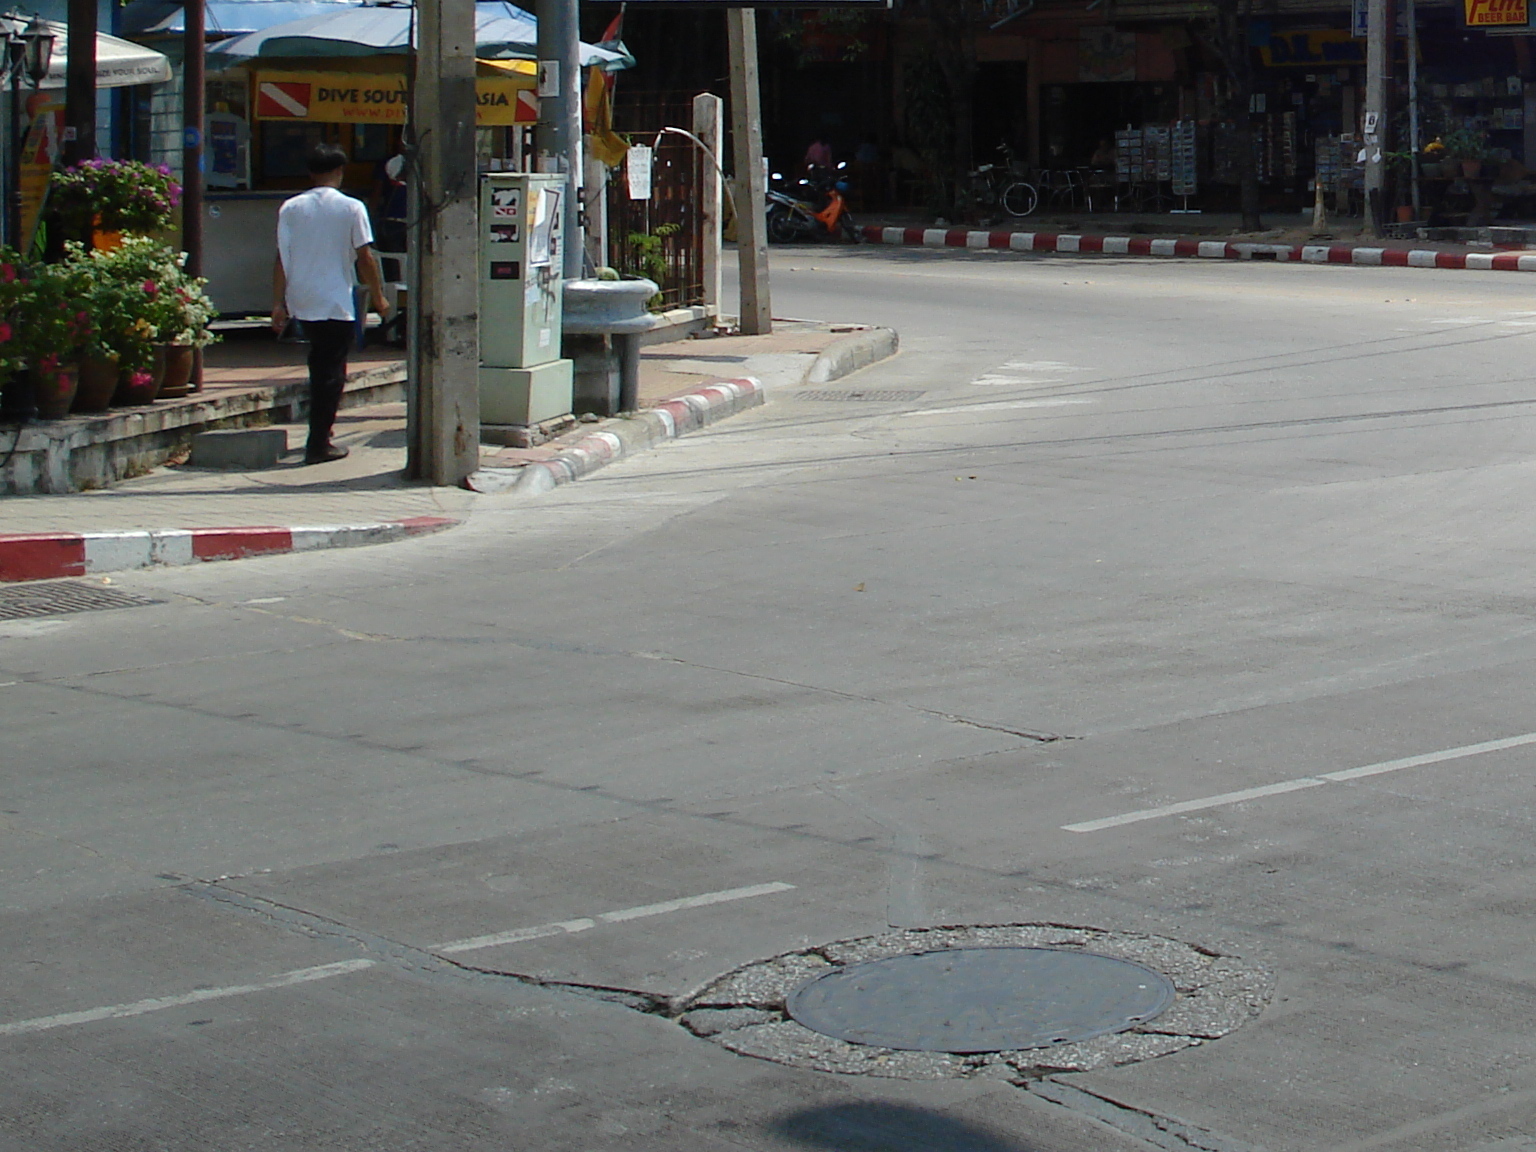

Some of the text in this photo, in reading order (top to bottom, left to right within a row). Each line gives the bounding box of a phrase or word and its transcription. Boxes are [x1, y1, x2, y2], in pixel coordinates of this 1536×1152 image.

[1478, 11, 1526, 23] BEER BAR
[317, 87, 359, 104] DIVE
[363, 88, 408, 105] SOUT
